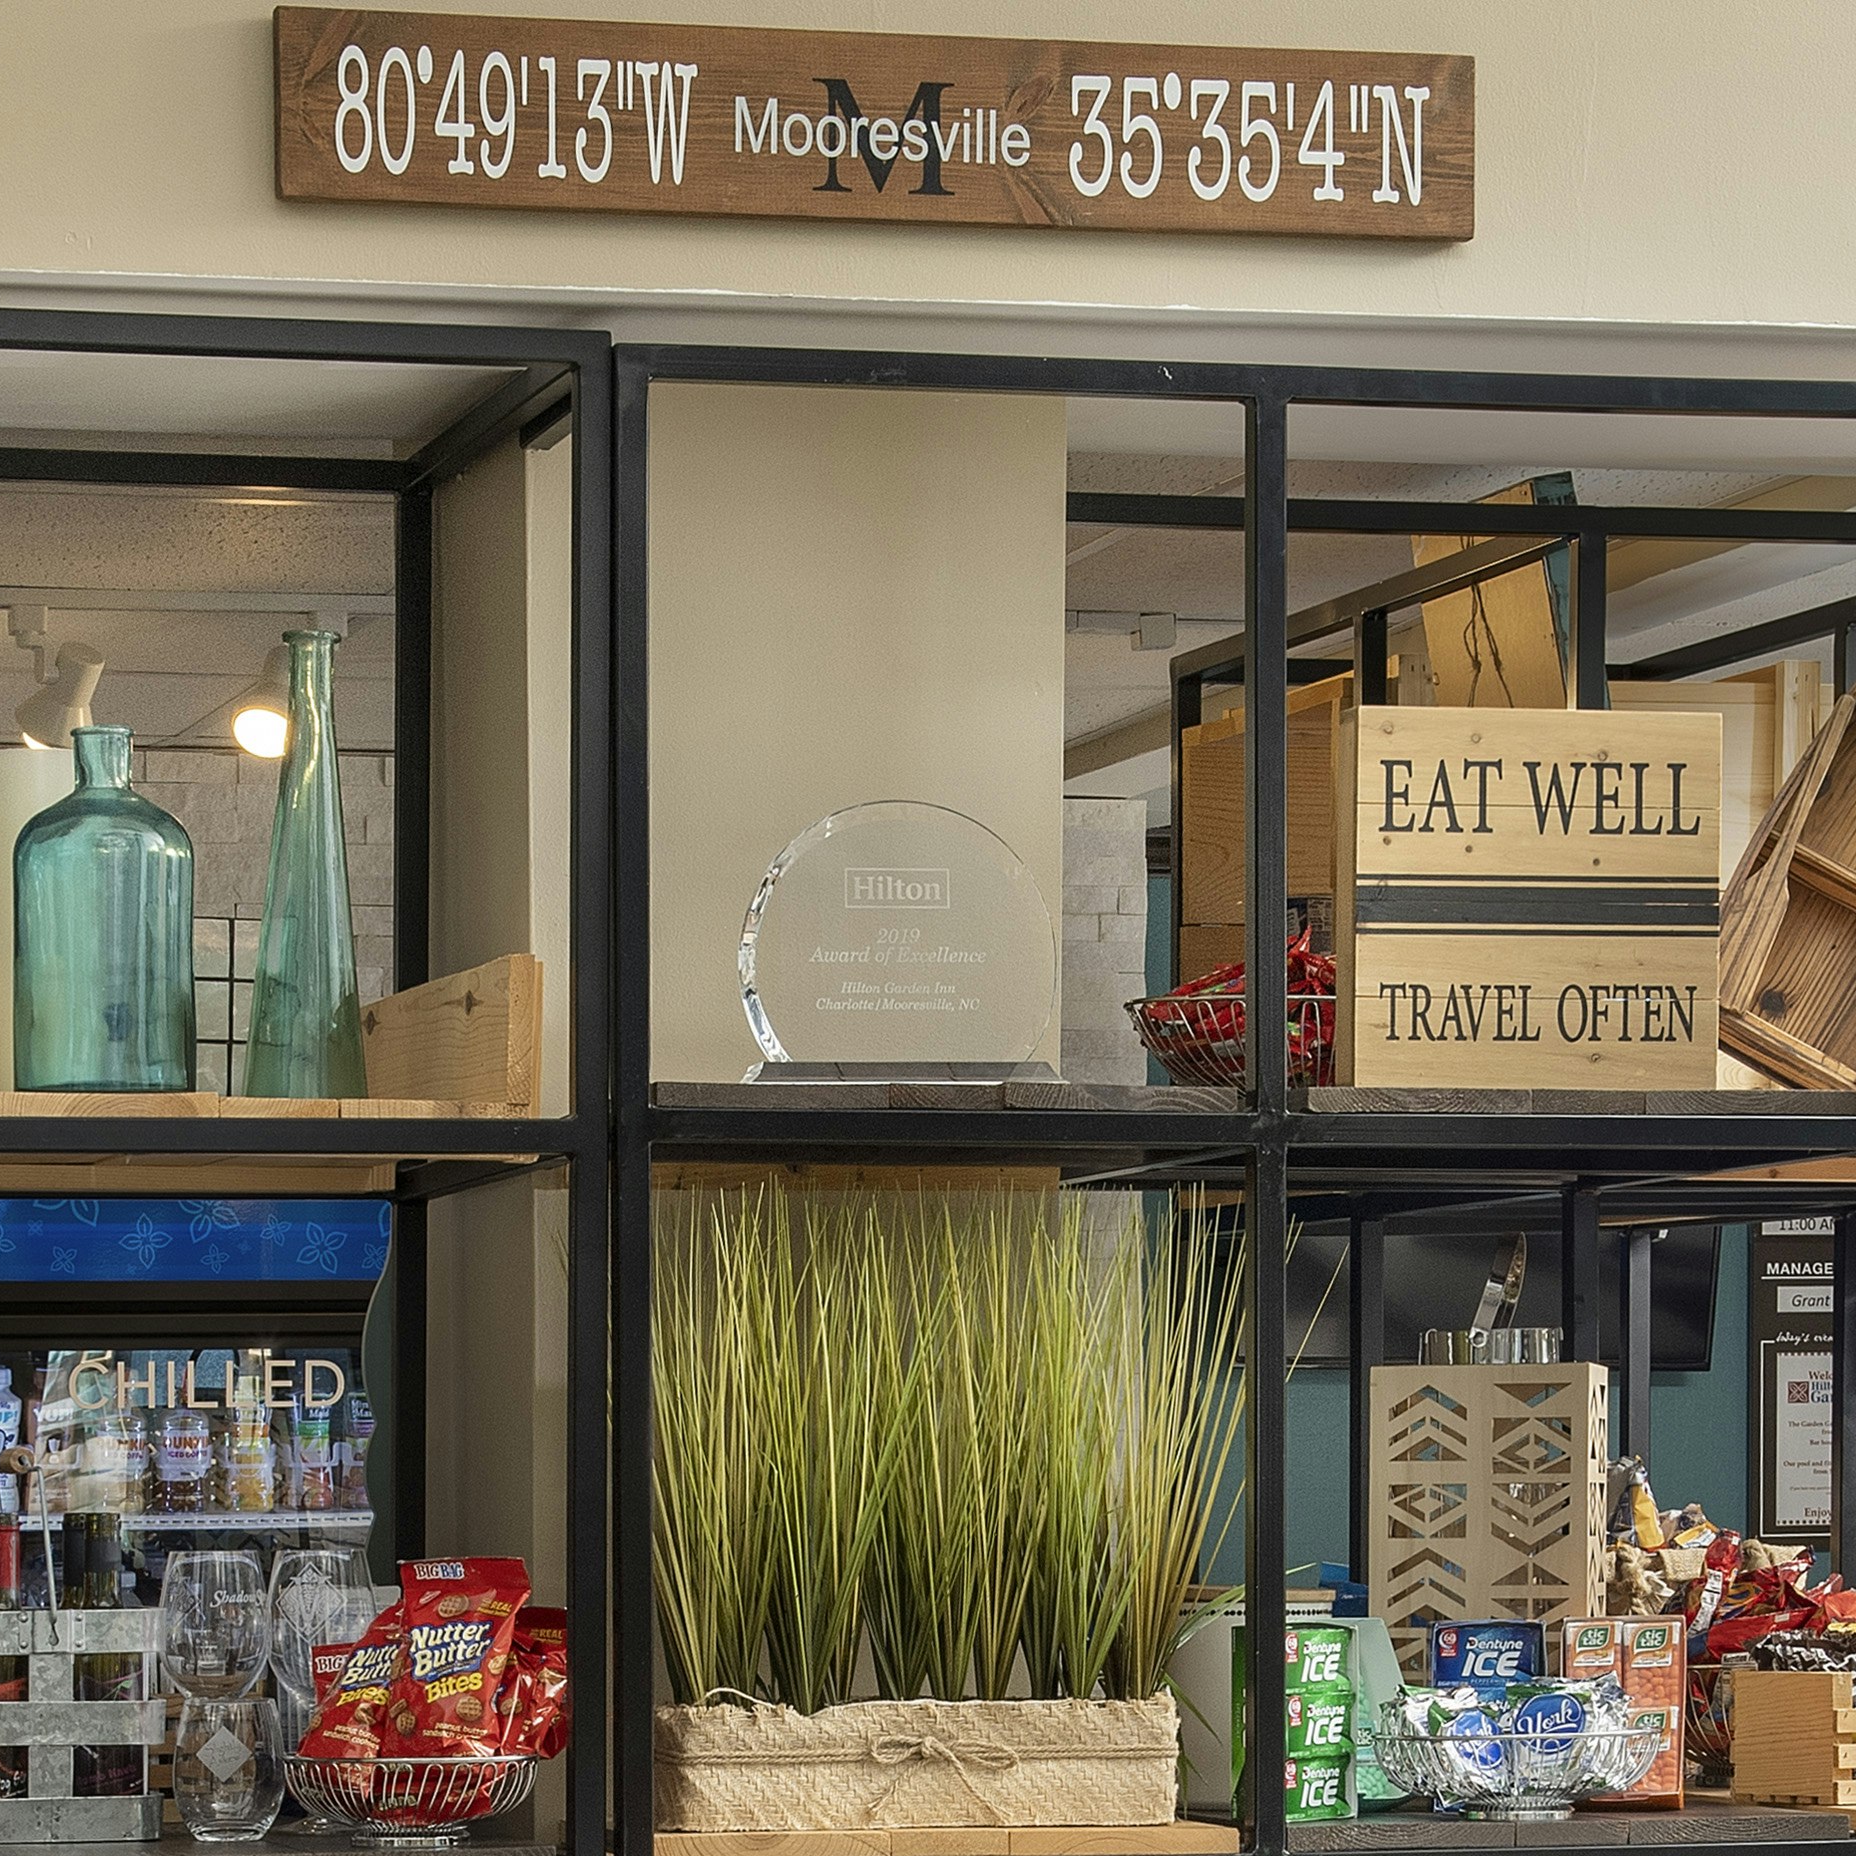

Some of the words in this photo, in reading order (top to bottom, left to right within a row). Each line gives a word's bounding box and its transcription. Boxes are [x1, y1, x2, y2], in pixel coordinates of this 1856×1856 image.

[731, 94, 1033, 169] Mooresville
[812, 77, 956, 197] M
[1378, 758, 1503, 834] EAT
[1522, 762, 1701, 835] WELL
[852, 875, 942, 900] Hilton
[876, 928, 921, 944] 2019
[808, 946, 870, 964] Award
[874, 945, 891, 965] of
[896, 946, 987, 963] Excellence
[884, 981, 930, 996] Garden
[959, 998, 981, 1011] NC
[1379, 981, 1542, 1042] TRAVEL
[1556, 983, 1698, 1043] OFTEN
[1765, 1262, 1834, 1275] MANAGE
[1791, 1294, 1831, 1308] Grant
[68, 1360, 346, 1410] CHILLED
[33, 1407, 74, 1423] YUP!
[413, 1562, 441, 1580] BIG
[439, 1562, 465, 1580] BAG
[410, 1621, 492, 1653] Nutter
[1582, 1635, 1606, 1648] tac
[1587, 1627, 1606, 1640] tic
[1640, 1637, 1663, 1648] tac
[1643, 1628, 1663, 1641] tic
[1302, 1641, 1342, 1654] Dentyne
[1465, 1636, 1524, 1651] Dentyne
[413, 1638, 492, 1677] Butter
[1461, 1651, 1522, 1677] ICE
[1300, 1653, 1341, 1683] ICE
[425, 1671, 485, 1704] Bites
[1306, 1704, 1346, 1718] Dentyne
[1516, 1700, 1581, 1736] York
[1642, 1713, 1661, 1727] tic
[1304, 1716, 1345, 1746] ICE
[1301, 1766, 1341, 1780] Dentyne
[1300, 1778, 1340, 1808] ICE
